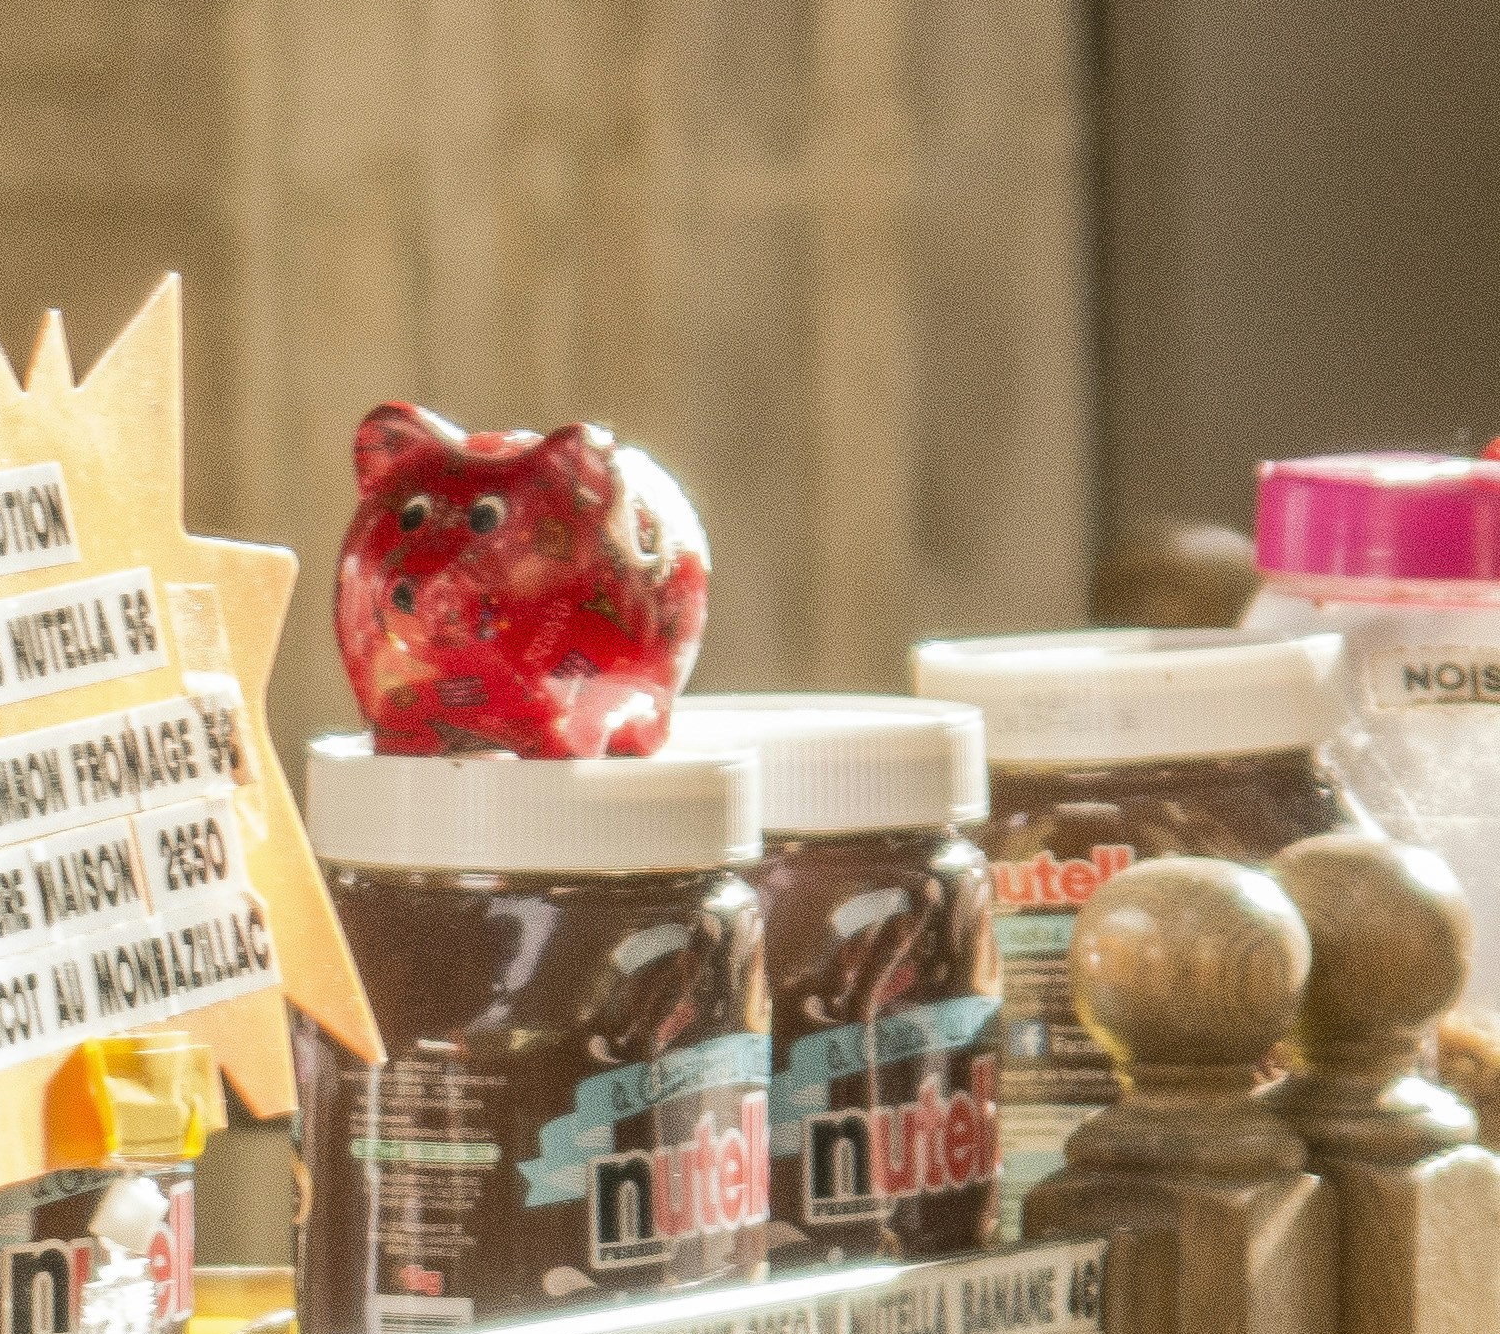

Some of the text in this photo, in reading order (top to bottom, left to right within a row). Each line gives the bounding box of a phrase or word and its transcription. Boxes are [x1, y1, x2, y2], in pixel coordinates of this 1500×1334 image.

[9, 601, 120, 683] NUTELLA
[121, 589, 158, 655] 5€
[70, 719, 198, 798] FROMAGE
[157, 817, 229, 893] 2€50
[53, 962, 87, 1031] AU
[91, 913, 274, 1016] MONBAZILLAC
